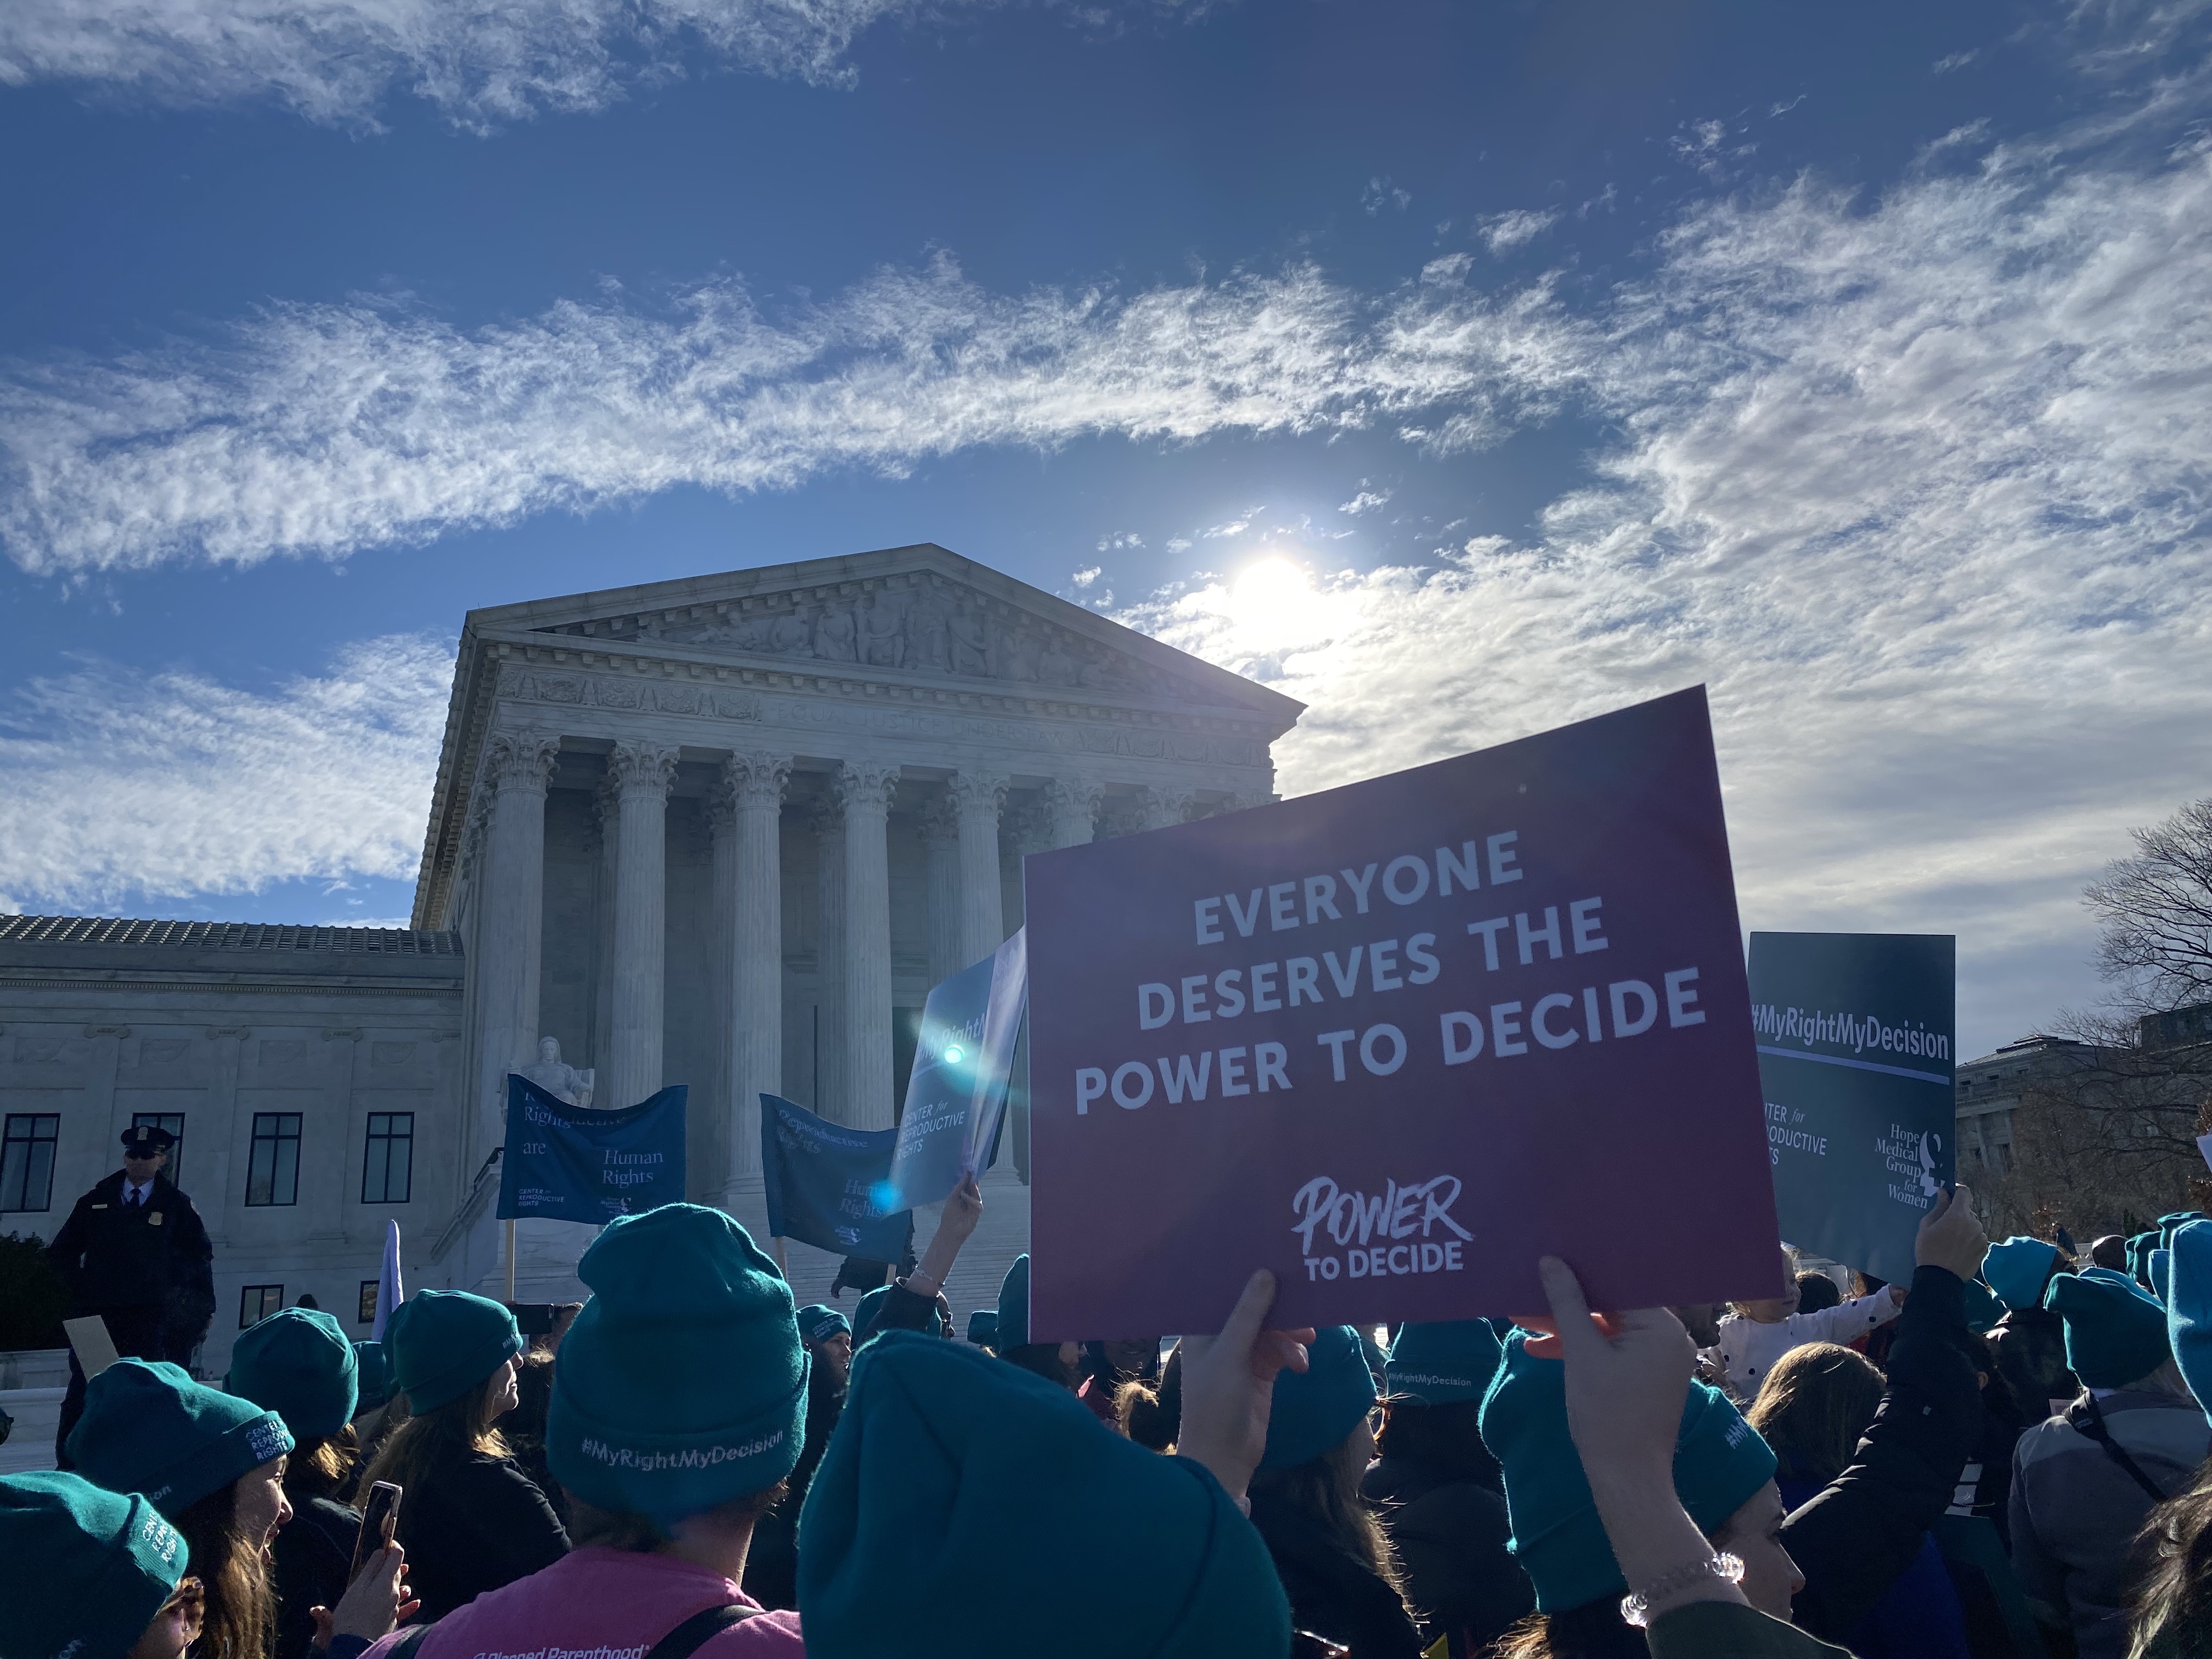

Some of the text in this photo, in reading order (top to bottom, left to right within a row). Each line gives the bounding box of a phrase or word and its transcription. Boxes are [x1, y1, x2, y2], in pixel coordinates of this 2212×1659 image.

[777, 702, 1066, 743] EQUAL JUSTICE UNDER LAW
[1194, 830, 1523, 946] EVERYONE
[1138, 896, 1609, 1030] DESERVES THE
[1075, 966, 1706, 1115] POWER TO DECIDE
[1751, 1003, 1949, 1060] #MyRightMyDecision
[933, 1100, 949, 1116] for
[1763, 1102, 1806, 1125] TER for
[523, 1141, 546, 1155] are
[1766, 1125, 1827, 1155] ODUCTIVE
[1891, 1124, 1920, 1148] Hope
[603, 1149, 664, 1165] Human
[1875, 1138, 1918, 1162] Medical
[602, 1170, 654, 1189] Rights
[1886, 1156, 1921, 1183] Group
[1888, 1183, 1928, 1209] Women
[1904, 1179, 1918, 1193] for
[1290, 1174, 1474, 1256] POWER
[1304, 1240, 1464, 1282] TO DECIDE
[1389, 1373, 1471, 1387] #MyRightMyDecision
[582, 1430, 783, 1472] #MyRightMyDecision
